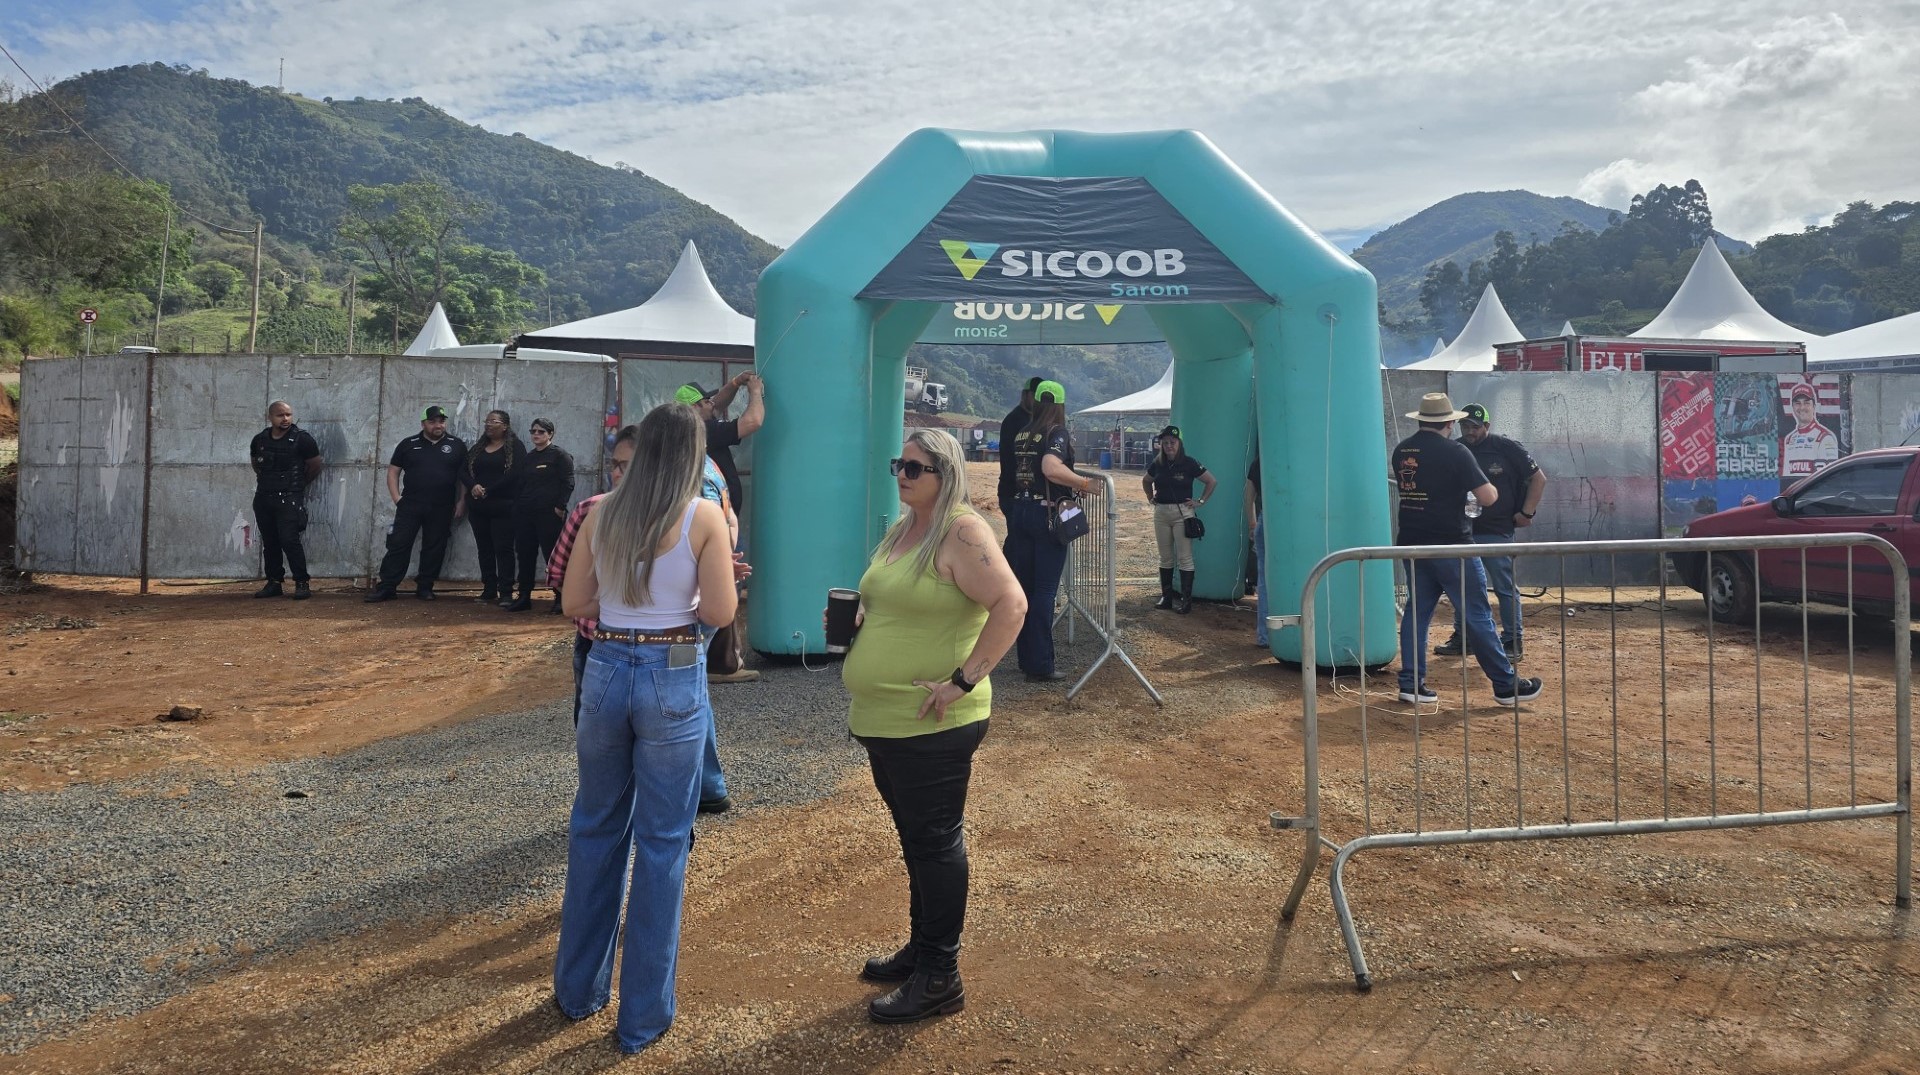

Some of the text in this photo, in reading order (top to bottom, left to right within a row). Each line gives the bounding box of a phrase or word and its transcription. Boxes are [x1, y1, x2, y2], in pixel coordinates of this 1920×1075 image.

[1001, 249, 1187, 277] SICOOB
[1111, 282, 1189, 297] Sarom
[1716, 459, 1778, 472] ABREU
